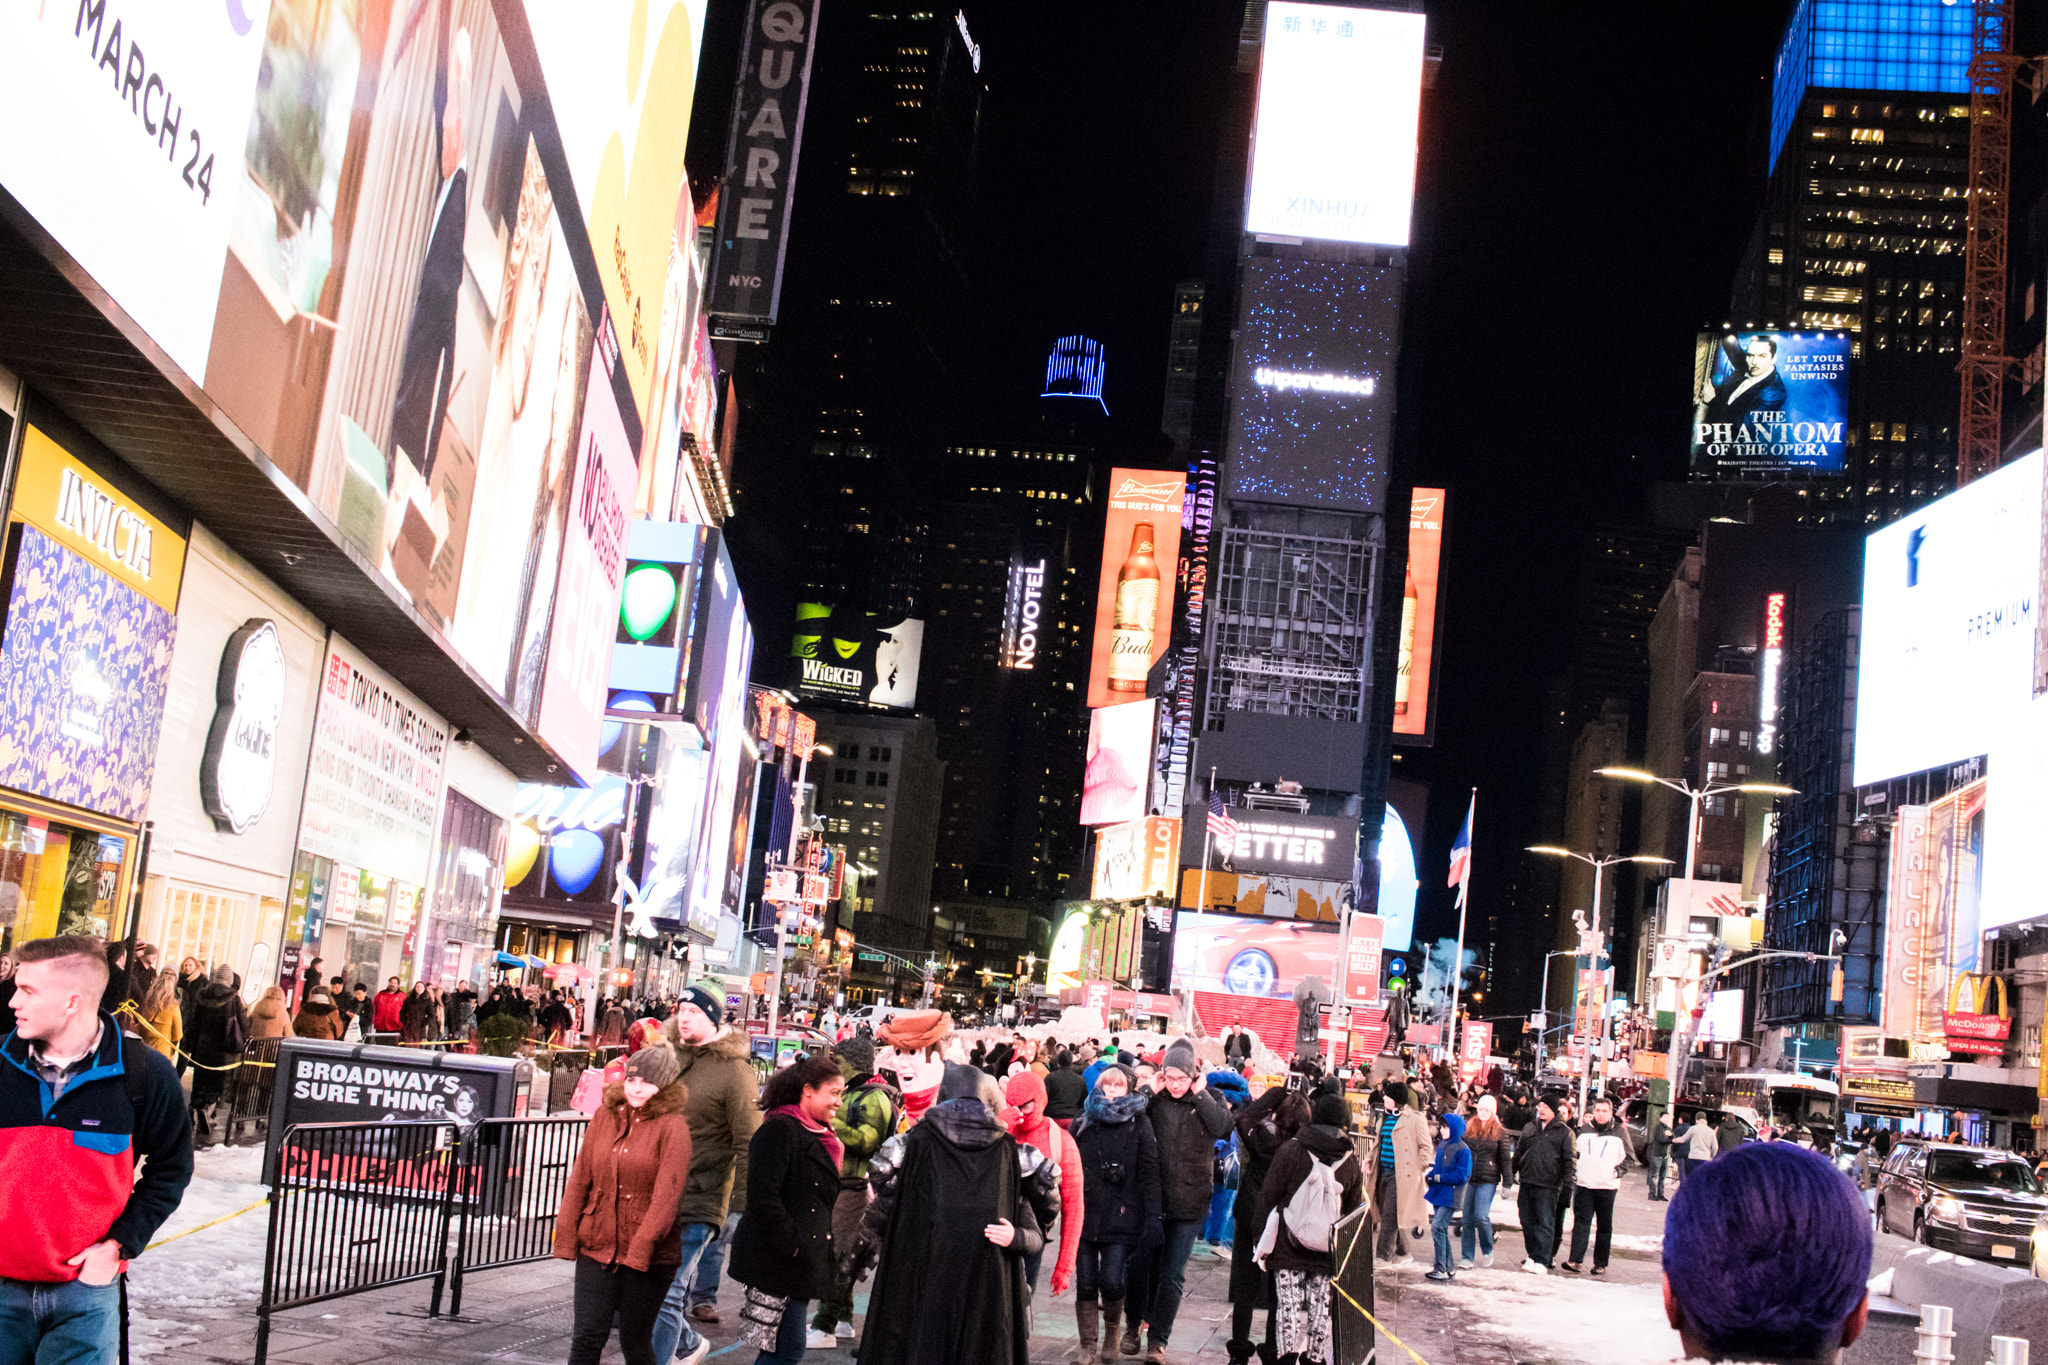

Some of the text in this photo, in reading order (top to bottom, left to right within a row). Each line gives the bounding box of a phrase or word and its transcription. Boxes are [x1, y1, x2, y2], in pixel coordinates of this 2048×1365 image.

[75, 0, 215, 207] MARCH 24
[729, 273, 762, 289] NYC
[1784, 363, 1845, 371] FANTASIES
[1787, 355, 1844, 363] LET YOUR
[1791, 372, 1838, 380] UNWIND
[1750, 411, 1786, 423] THE
[1695, 422, 1843, 445] PHANTOM
[1707, 443, 1829, 456] OF THE OPERA
[1121, 483, 1174, 496] Budweiser
[1110, 500, 1183, 514] THIS BUD'S FOR YOU.
[56, 467, 155, 580] INVICTA
[1014, 559, 1046, 669] NOVOTEL
[1765, 593, 1785, 648] Kodak
[1967, 597, 2031, 642] PREMIUM
[350, 668, 445, 766] TOKYO TO TIMES SQUARE
[320, 702, 347, 748] PARIS
[347, 722, 381, 766] LONDON
[379, 740, 399, 776] NEW
[398, 747, 416, 786] YORK
[314, 744, 336, 780] HONG
[336, 755, 355, 789] KONG
[357, 766, 384, 803] TORONTO
[1901, 823, 1925, 986] PALACE
[1350, 944, 1380, 955] MIDLER
[1351, 936, 1380, 947] BETTE
[1947, 1018, 2008, 1032] McDonald's
[1470, 1025, 1488, 1061] tkts
[296, 1060, 461, 1095] BROADWAY'S
[293, 1080, 446, 1112] SURE THING
